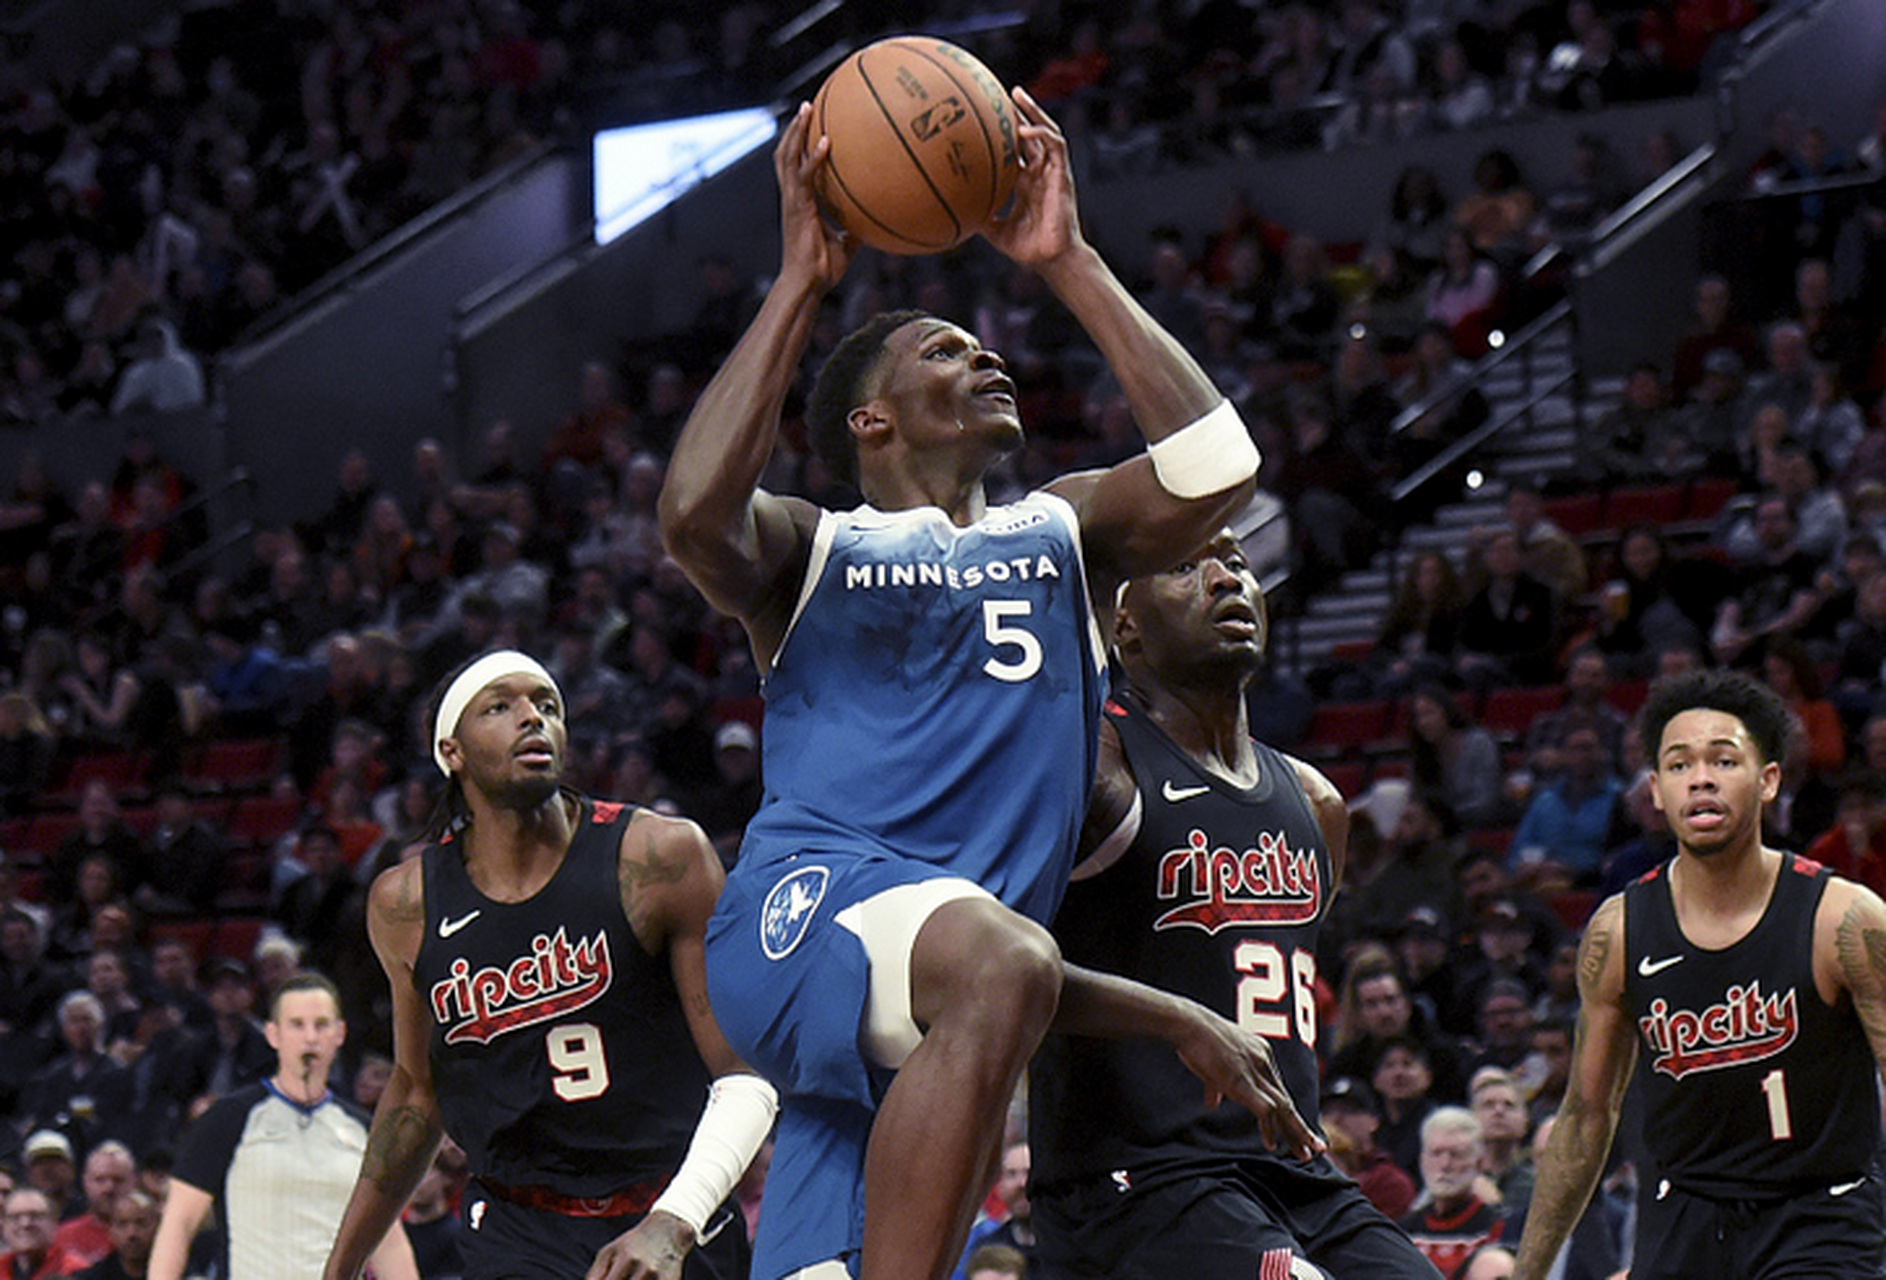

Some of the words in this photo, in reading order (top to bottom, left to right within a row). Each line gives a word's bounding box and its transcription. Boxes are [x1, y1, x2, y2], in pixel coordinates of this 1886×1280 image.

[846, 555, 1059, 590] MINNESOTA
[982, 599, 1044, 683] 5
[1234, 938, 1317, 1049] 26
[545, 1022, 610, 1103] 9
[1761, 1069, 1793, 1140] 1
